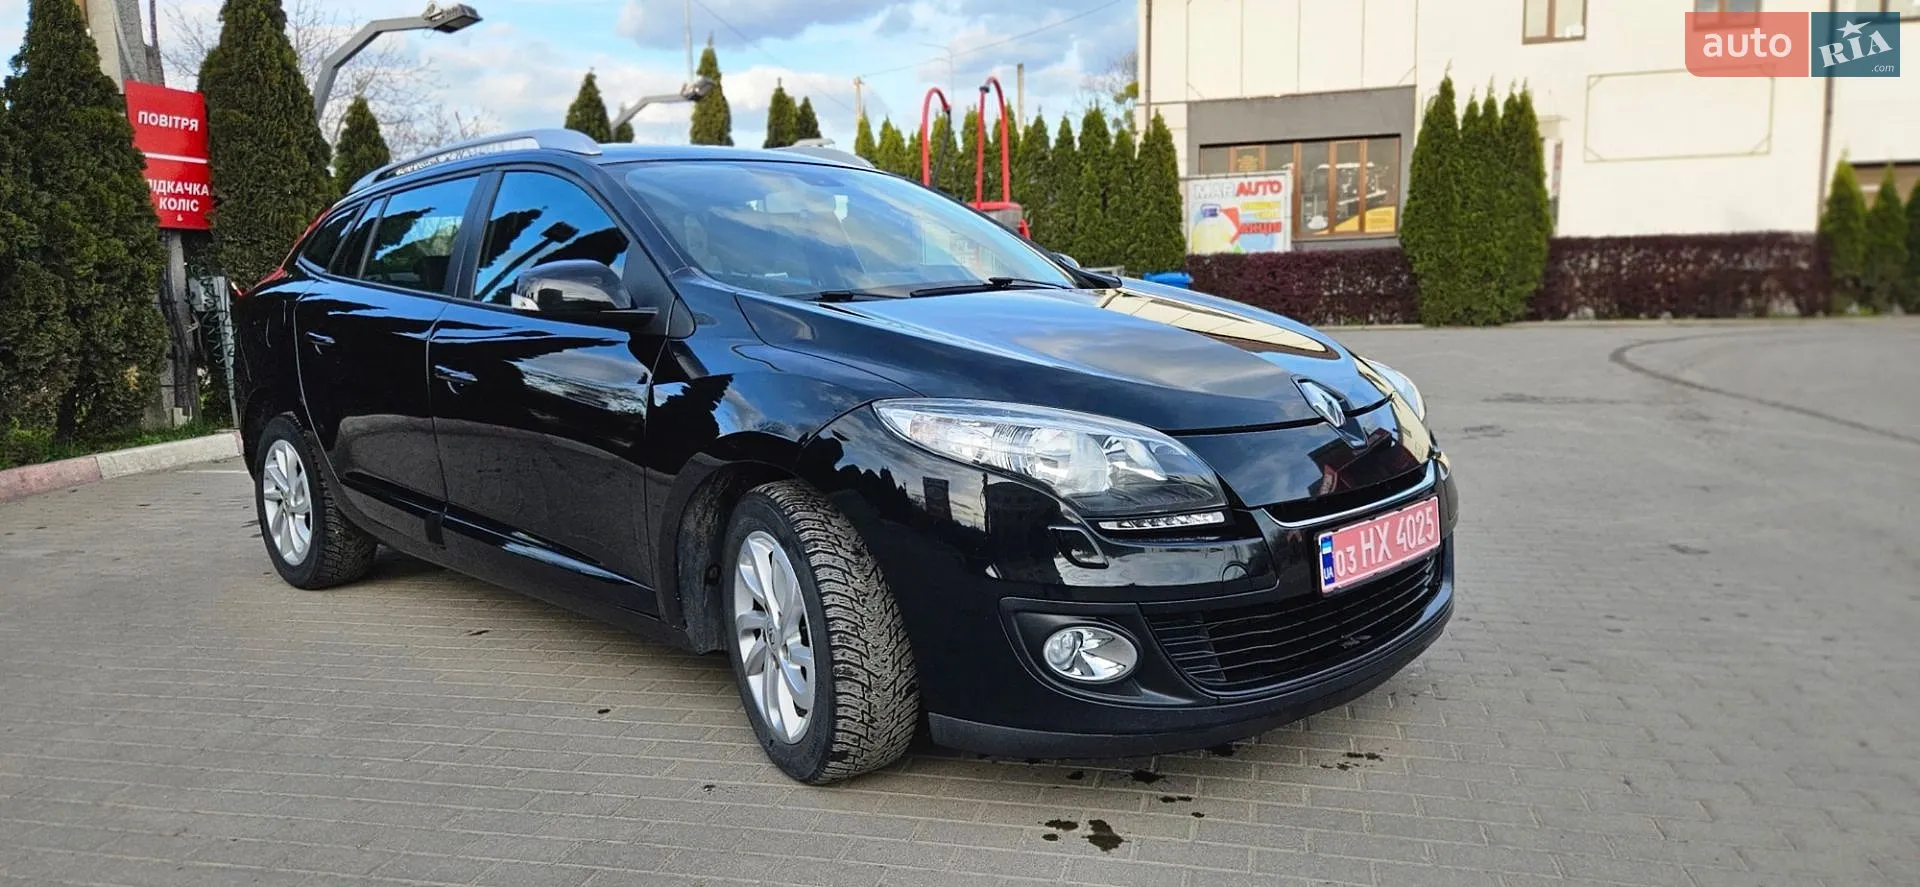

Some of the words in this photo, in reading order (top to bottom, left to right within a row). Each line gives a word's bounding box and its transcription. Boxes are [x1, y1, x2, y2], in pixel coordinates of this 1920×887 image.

[137, 110, 199, 132] ПОВІТРЯ
[159, 196, 200, 212] КОЛІС
[1335, 545, 1358, 578] 03
[1360, 521, 1393, 569] HX
[1395, 505, 1436, 553] 4025
[1322, 566, 1335, 581] UA
